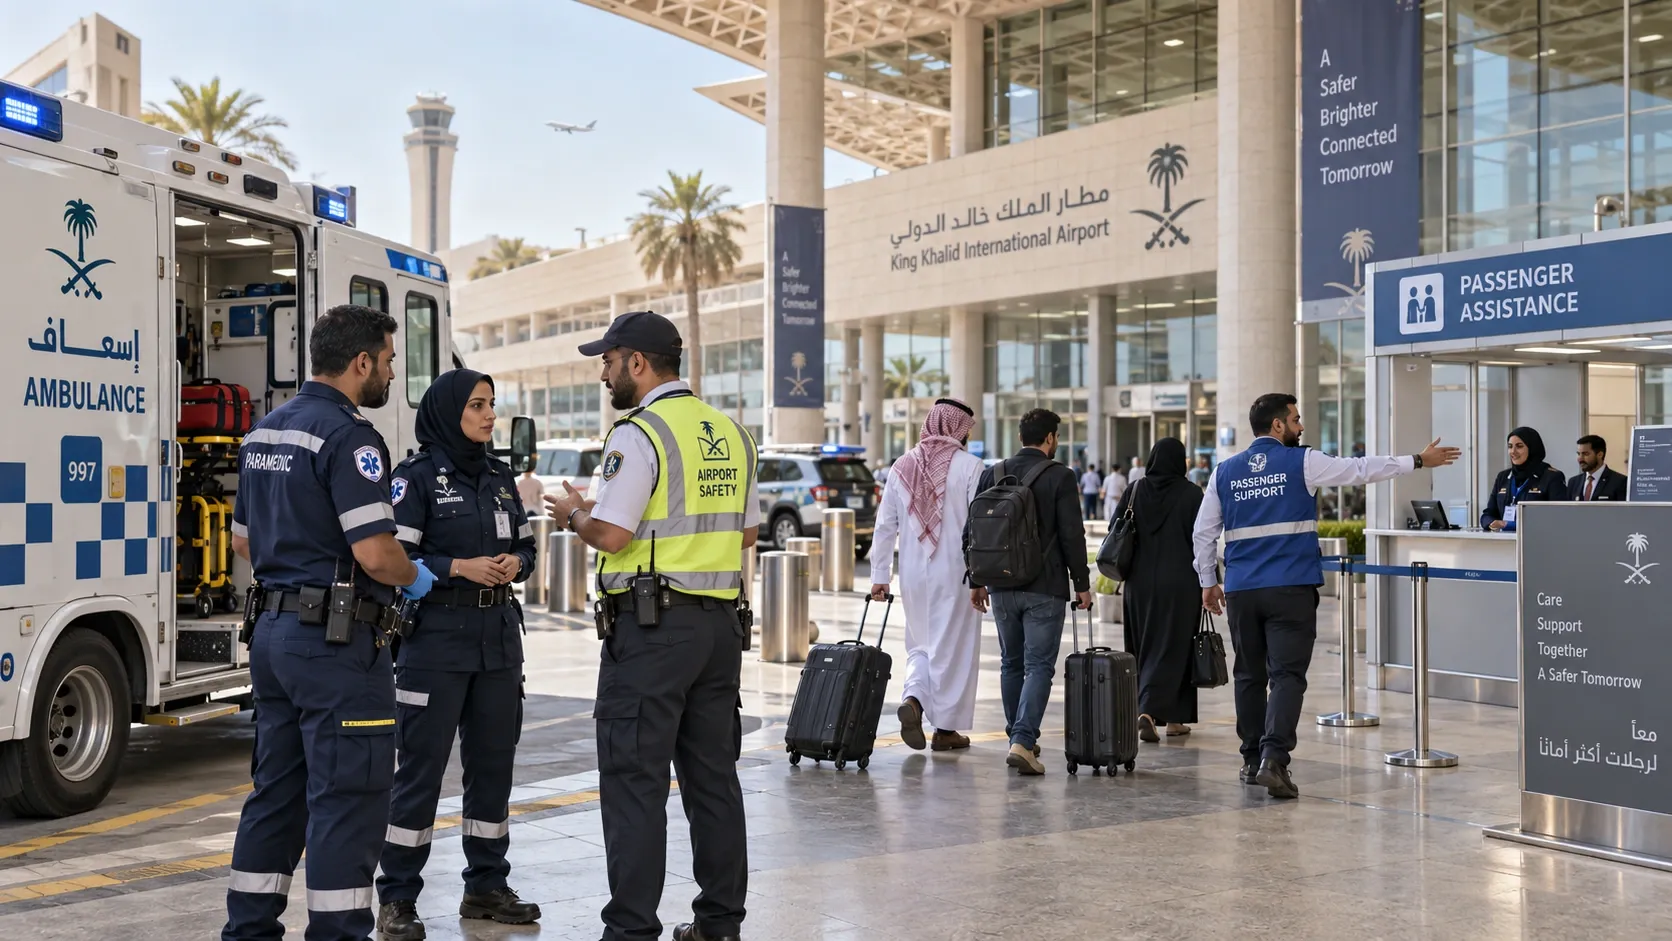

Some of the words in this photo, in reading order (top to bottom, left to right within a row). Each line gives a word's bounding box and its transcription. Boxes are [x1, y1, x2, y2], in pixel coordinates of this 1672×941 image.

[1320, 49, 1331, 68] A
[1320, 74, 1357, 97] Safer
[1320, 101, 1378, 127] Brighter
[1320, 123, 1397, 156] Connected
[1320, 159, 1394, 185] Tomorrow
[996, 192, 1050, 221] الملك
[1056, 185, 1109, 216] مطار
[951, 207, 989, 230] خالد
[890, 213, 945, 249] الدولي
[891, 253, 917, 273] King
[921, 242, 960, 267] Khalid
[965, 227, 1051, 259] International
[1056, 218, 1109, 245] Airport
[1460, 263, 1574, 295] PASSENGER
[1460, 291, 1578, 323] ASSISTANCE
[28, 317, 139, 373] إسعاف
[24, 377, 145, 413] AMBULANCE
[68, 461, 97, 482] 997
[245, 452, 293, 472] PARAMEDIC
[697, 468, 738, 482] AIRPORT
[1230, 473, 1287, 490] PASSENGER
[699, 484, 737, 497] SAFETY
[1234, 485, 1286, 501] SUPPORT
[1537, 592, 1563, 606] Care
[1537, 616, 1582, 634] Support
[1537, 641, 1588, 659] Together
[1537, 667, 1546, 680] A
[1549, 667, 1578, 683] Safer
[1581, 670, 1642, 689] Tomorrow
[1573, 742, 1600, 764] أكثر
